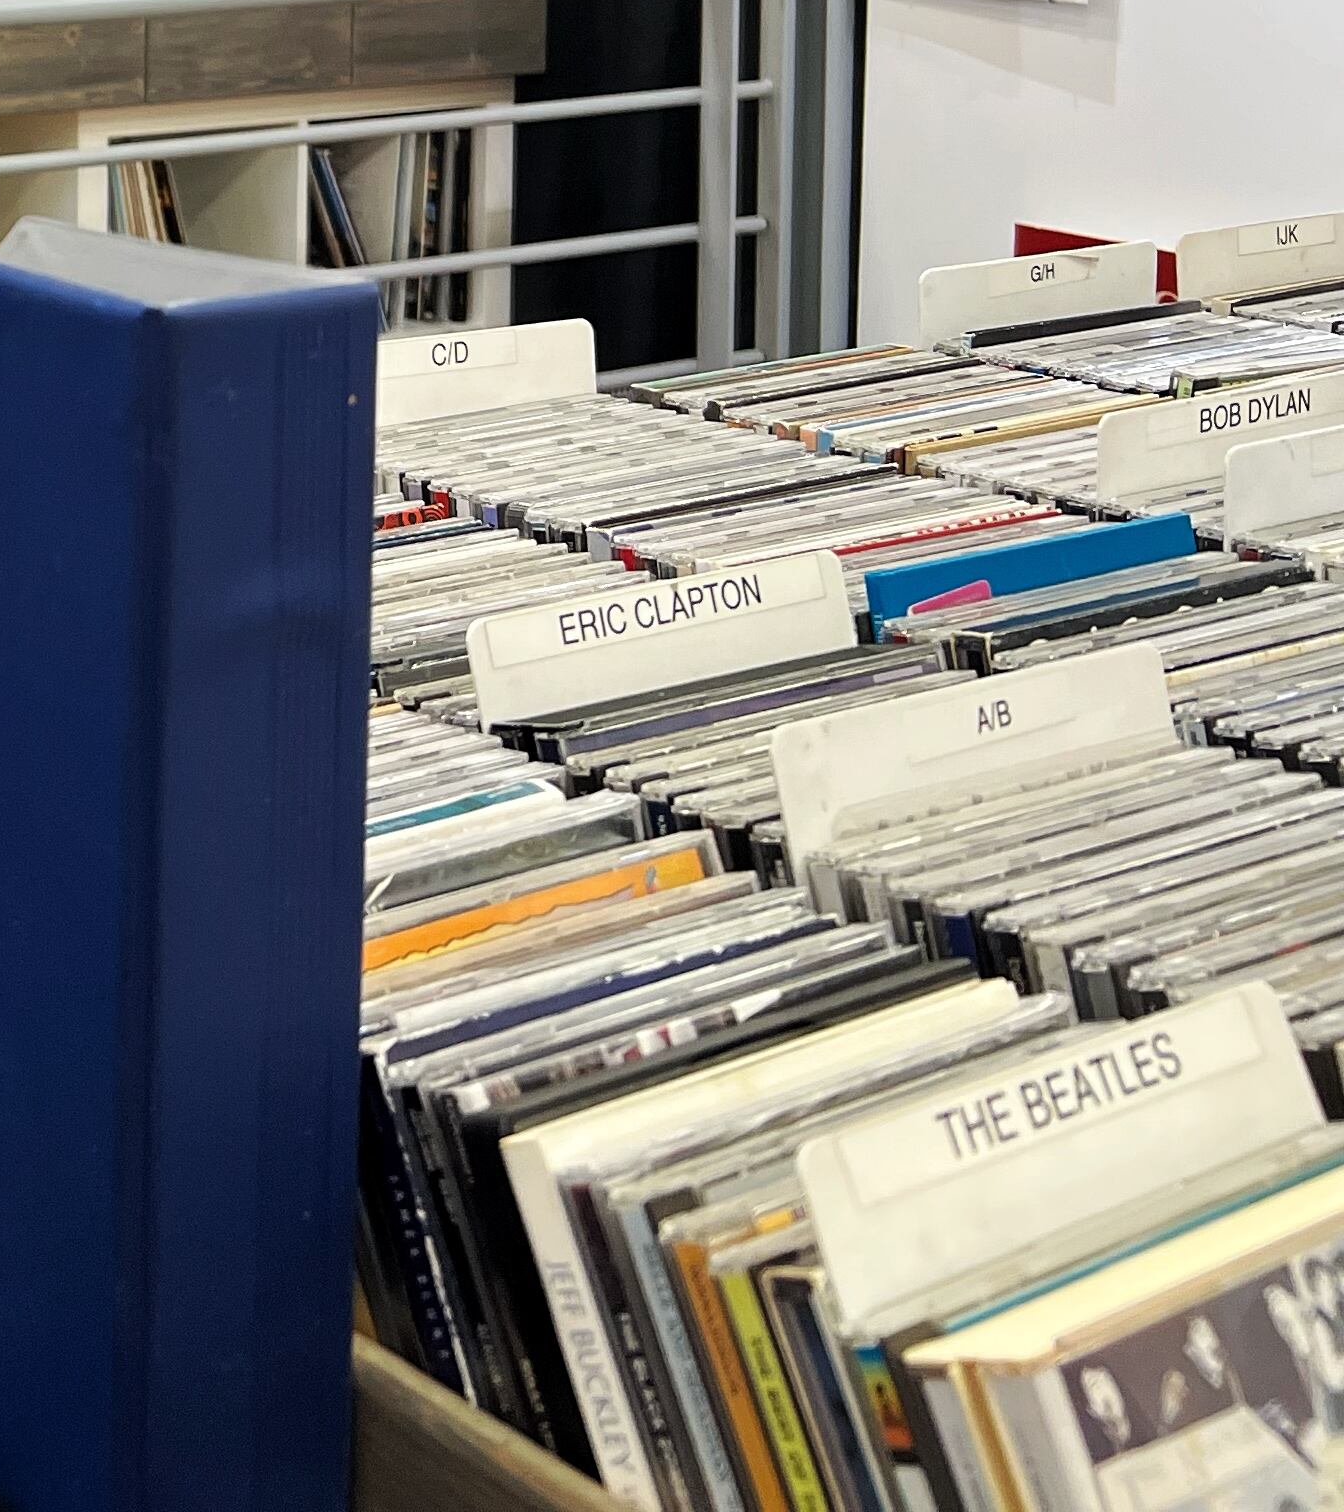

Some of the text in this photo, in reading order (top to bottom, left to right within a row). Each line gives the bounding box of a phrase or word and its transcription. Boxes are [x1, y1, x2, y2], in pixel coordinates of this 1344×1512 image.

[1275, 224, 1300, 246] IJK
[1030, 262, 1056, 283] G/H
[431, 341, 469, 367] C/D
[1199, 387, 1313, 434] BOB DYLAN
[559, 573, 763, 645] ERIC CLAPTON
[976, 699, 1013, 735] A/B
[934, 1031, 1184, 1160] THE BEATLES
[543, 1261, 638, 1475] JEFF BUCKLEY
